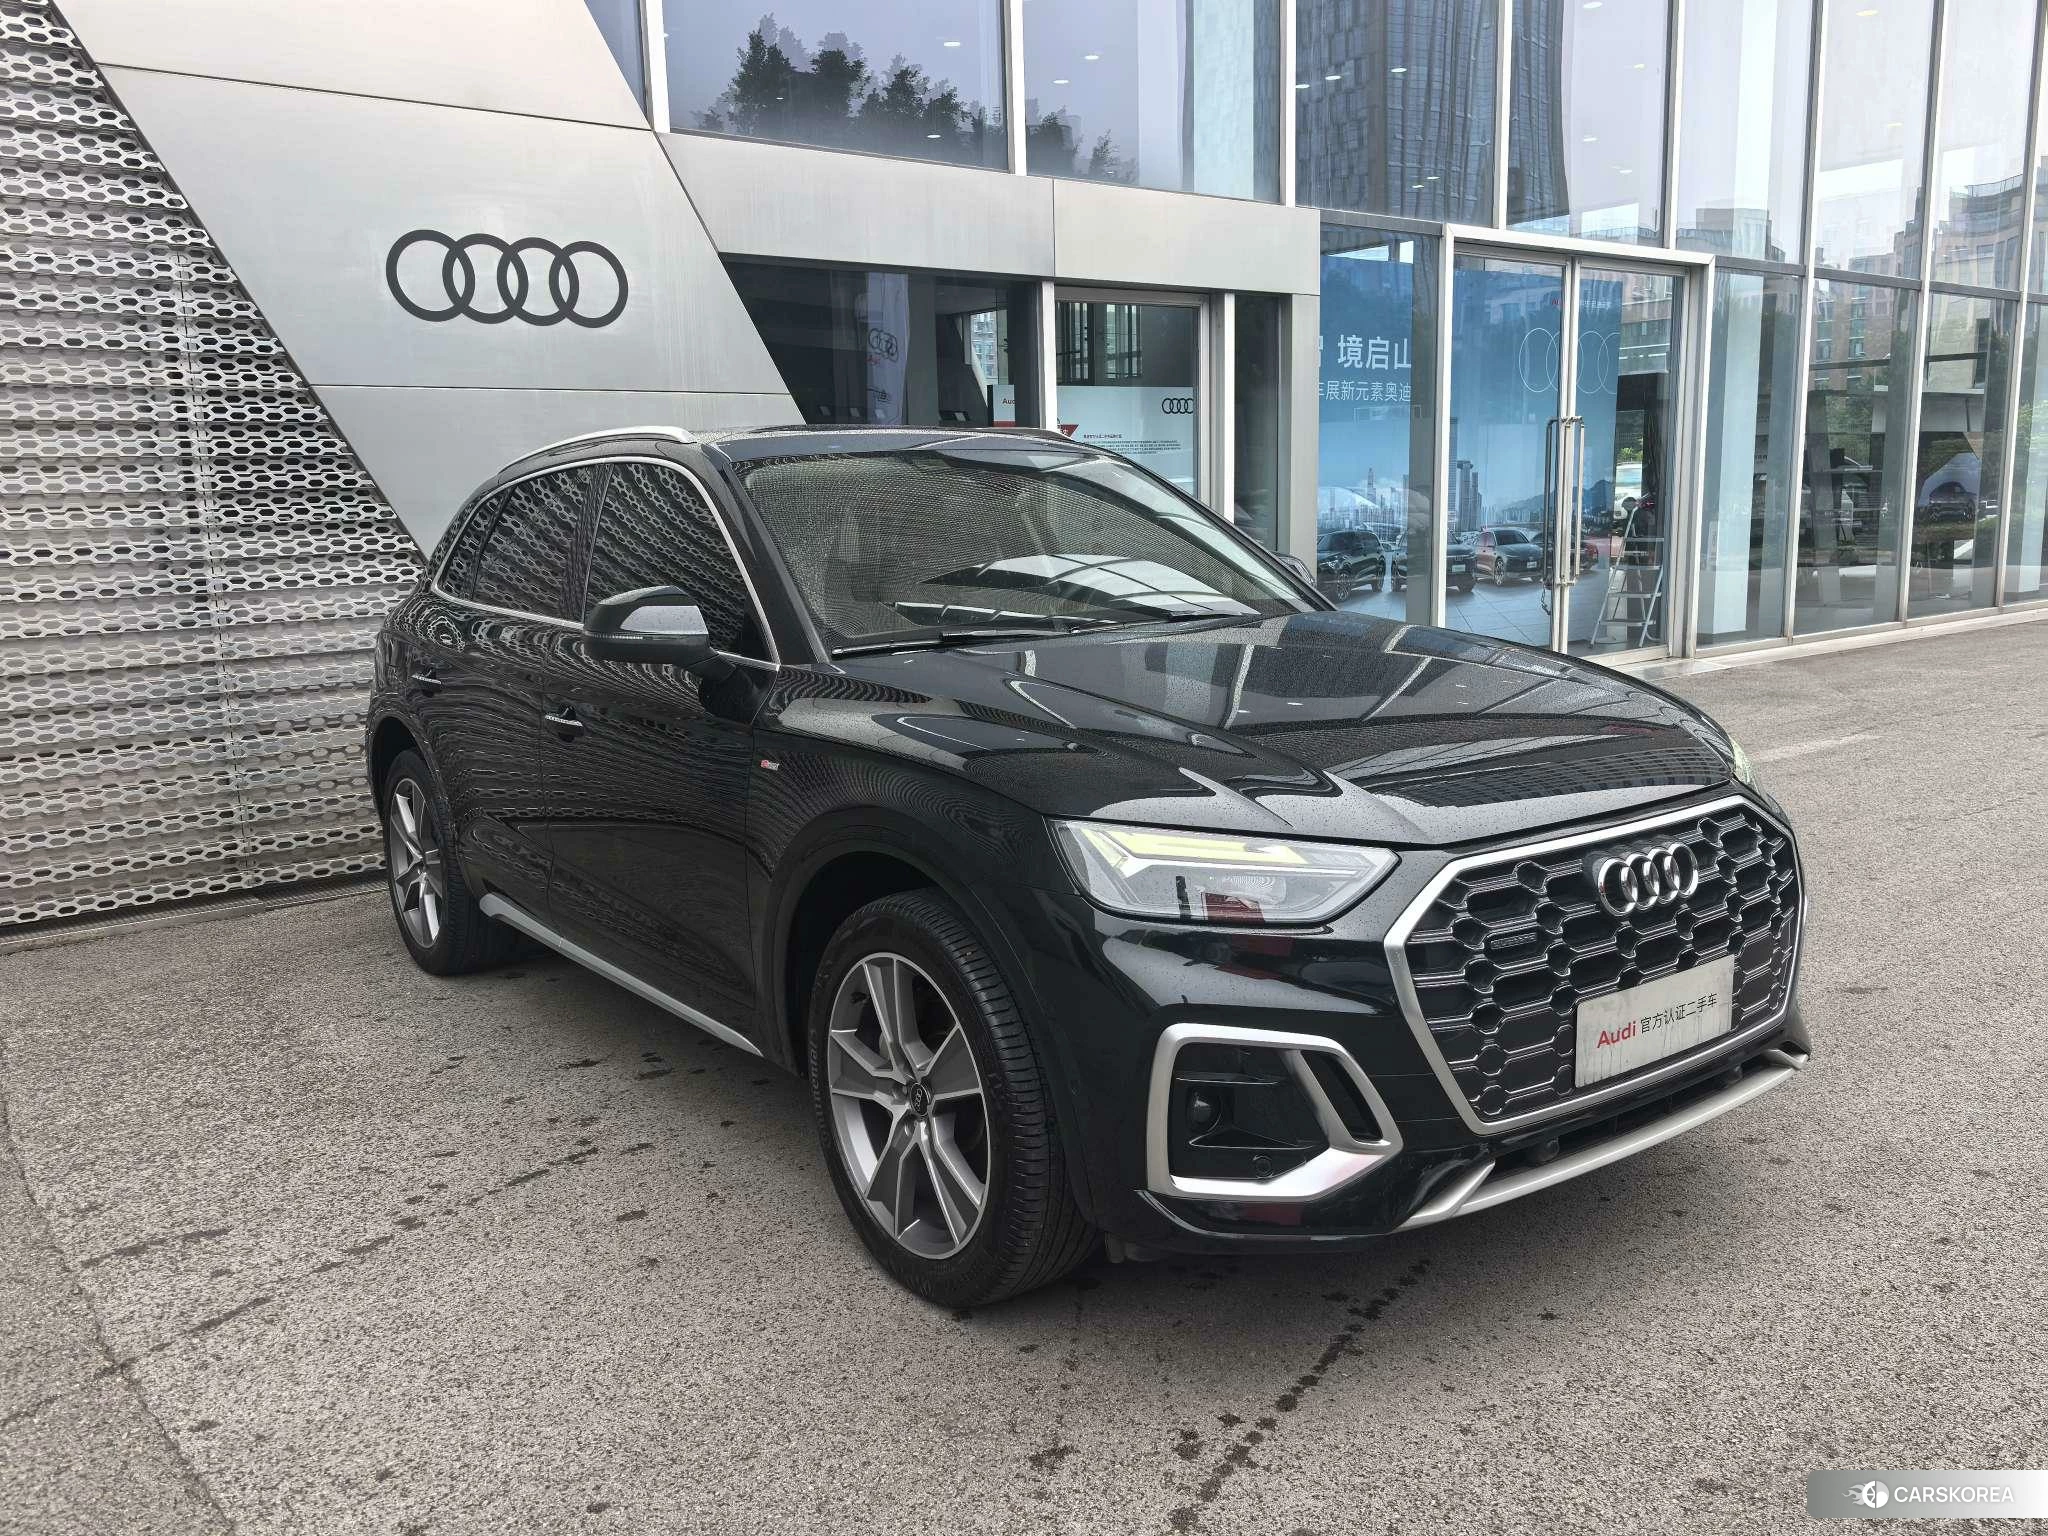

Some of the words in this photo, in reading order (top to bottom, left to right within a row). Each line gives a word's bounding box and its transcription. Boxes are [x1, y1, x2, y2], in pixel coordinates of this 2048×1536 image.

[1597, 1021, 1636, 1048] Audi
[1640, 993, 1718, 1034] 官方认证二手车
